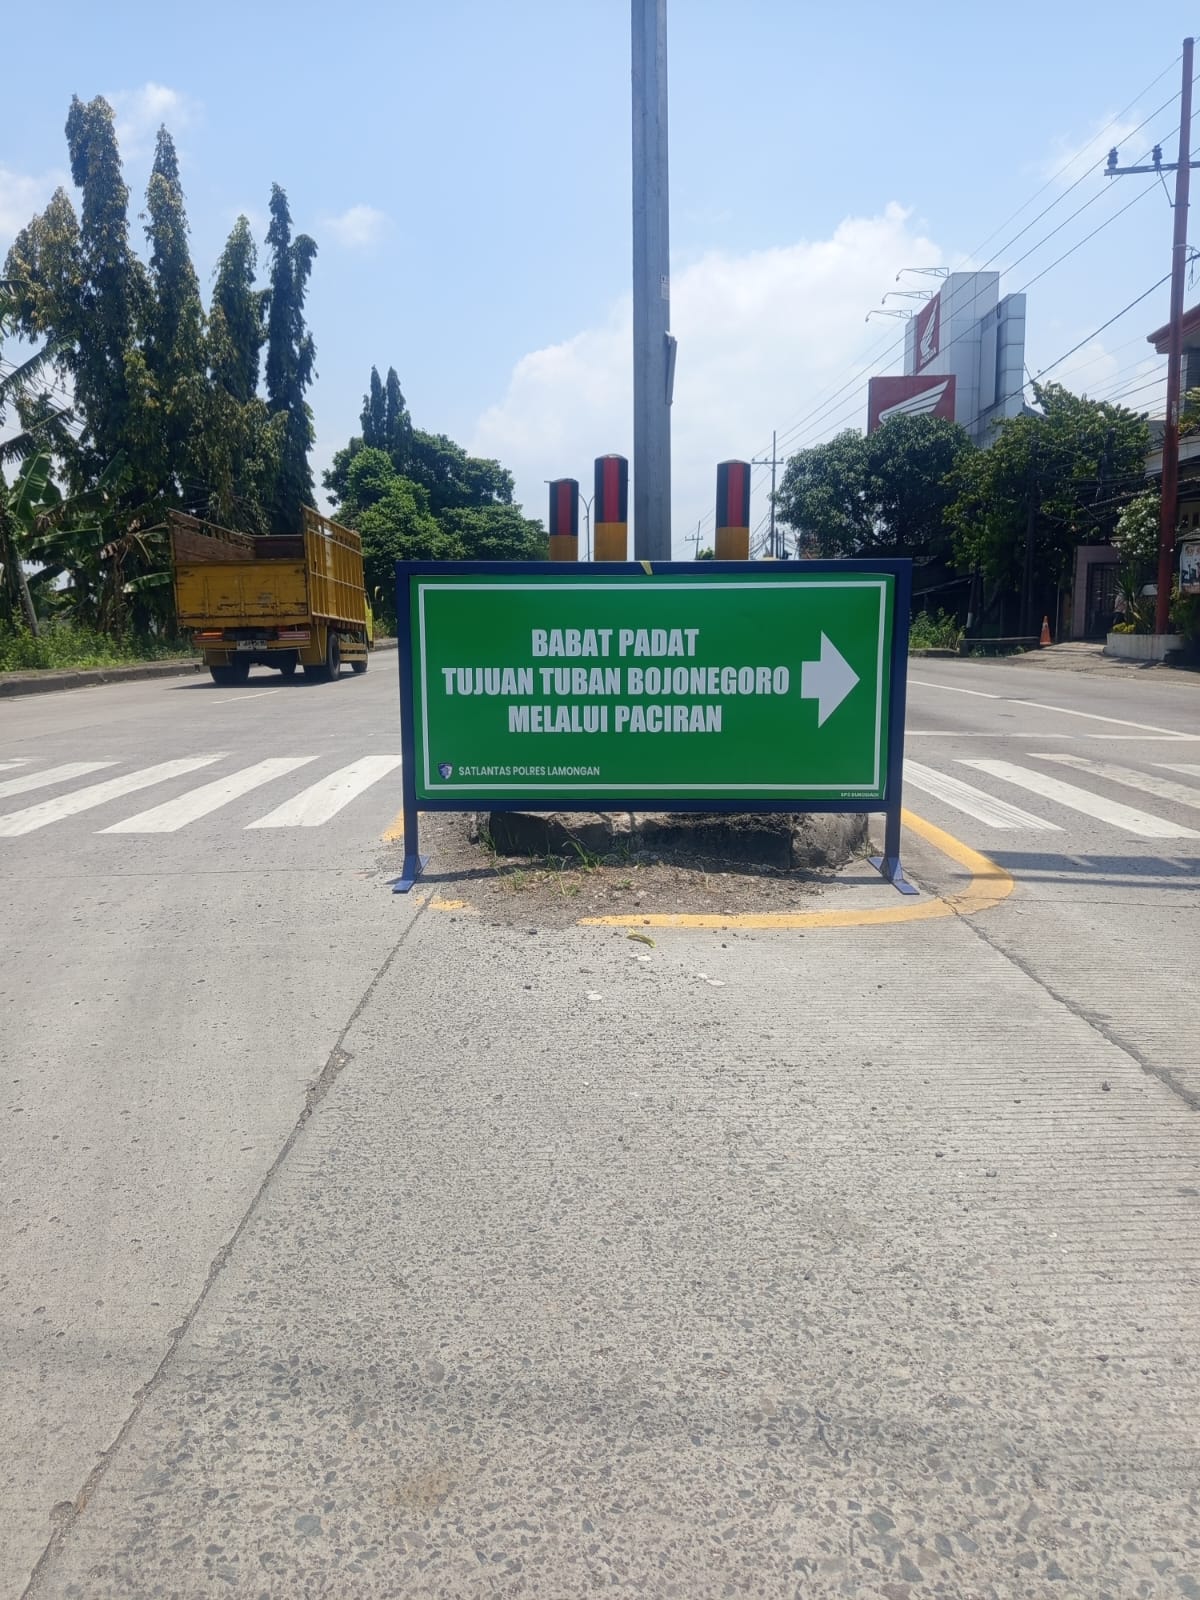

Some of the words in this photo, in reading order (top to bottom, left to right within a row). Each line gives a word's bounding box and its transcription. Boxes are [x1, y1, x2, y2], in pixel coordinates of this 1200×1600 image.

[531, 629, 613, 656] BABAT
[619, 628, 700, 656] PADAT
[441, 667, 534, 695] TUJUAN
[539, 667, 621, 695] TUBAN
[627, 666, 790, 695] BOJONEGORO
[508, 705, 608, 732] MELALUI
[615, 704, 722, 732] PACIRAN
[458, 766, 512, 776] SATLANTAS
[513, 766, 546, 776] POLRES
[547, 766, 600, 776] LAMONGAN
